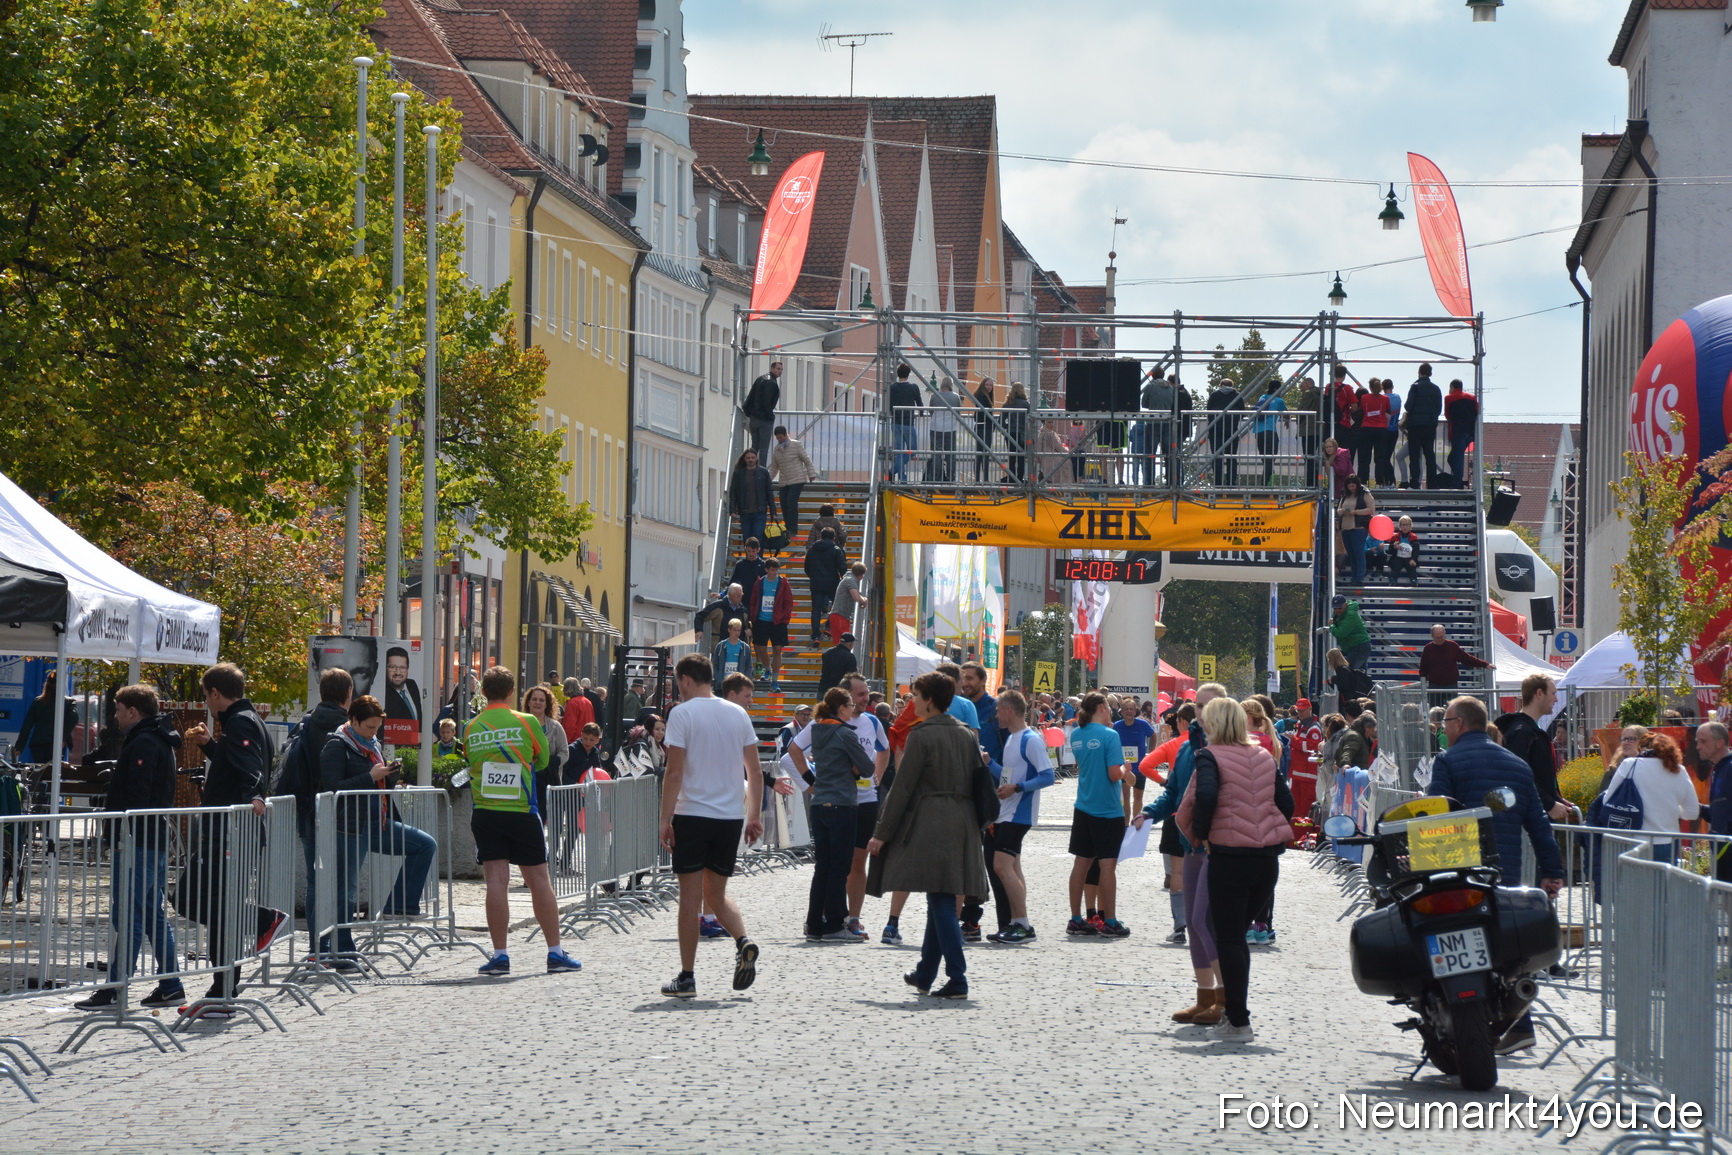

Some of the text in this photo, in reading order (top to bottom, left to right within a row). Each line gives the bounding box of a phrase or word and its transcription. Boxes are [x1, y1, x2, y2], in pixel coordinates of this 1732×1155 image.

[919, 519, 1008, 531] Neumarkter Stadtlauf
[1059, 509, 1151, 540] ZIEL
[1202, 526, 1292, 535] Neumarkter Stadtlauf
[1065, 561, 1144, 580] 12:08:17
[165, 618, 209, 658] BMW Laufsport
[1038, 662, 1055, 670] Block
[1203, 663, 1212, 675] B
[1038, 671, 1050, 686] A
[468, 727, 523, 747] BOCK
[860, 738, 872, 746] PA
[488, 773, 516, 785] 5247
[1418, 824, 1469, 836] Vorsicht!
[1439, 933, 1466, 953] NM
[1445, 949, 1488, 972] PC 3
